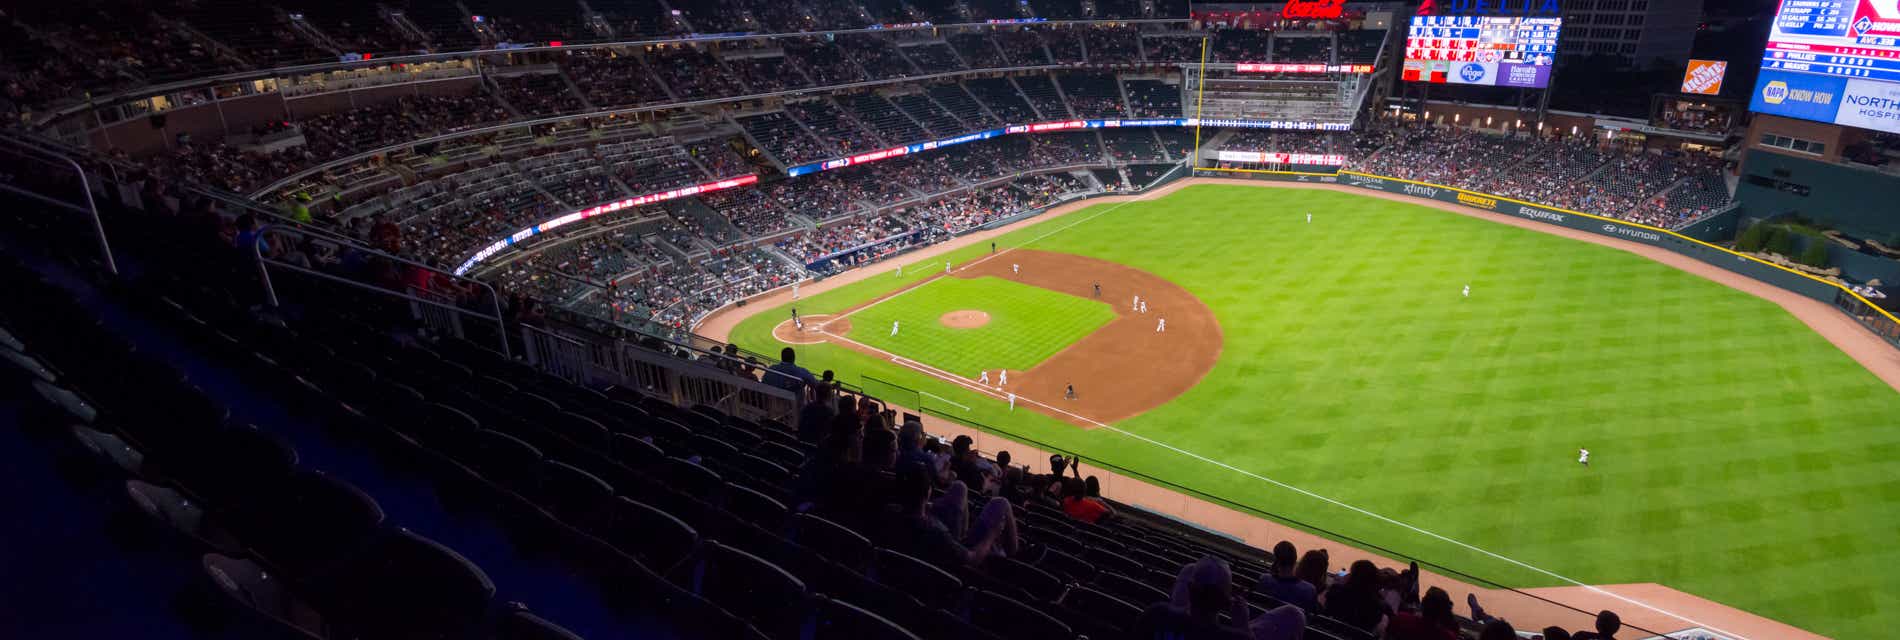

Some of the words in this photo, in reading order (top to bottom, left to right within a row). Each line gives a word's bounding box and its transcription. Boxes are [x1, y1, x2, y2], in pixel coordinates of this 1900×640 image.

[1786, 51, 1816, 61] PHILLIES
[1462, 65, 1483, 81] Kroger
[1766, 86, 1786, 99] NAPA
[1789, 88, 1814, 103] KNOW
[1812, 91, 1834, 105] HOW
[1402, 184, 1439, 198] xfinity
[1519, 206, 1565, 222] EQUIFAX
[1618, 227, 1661, 241] HYUNDAI
